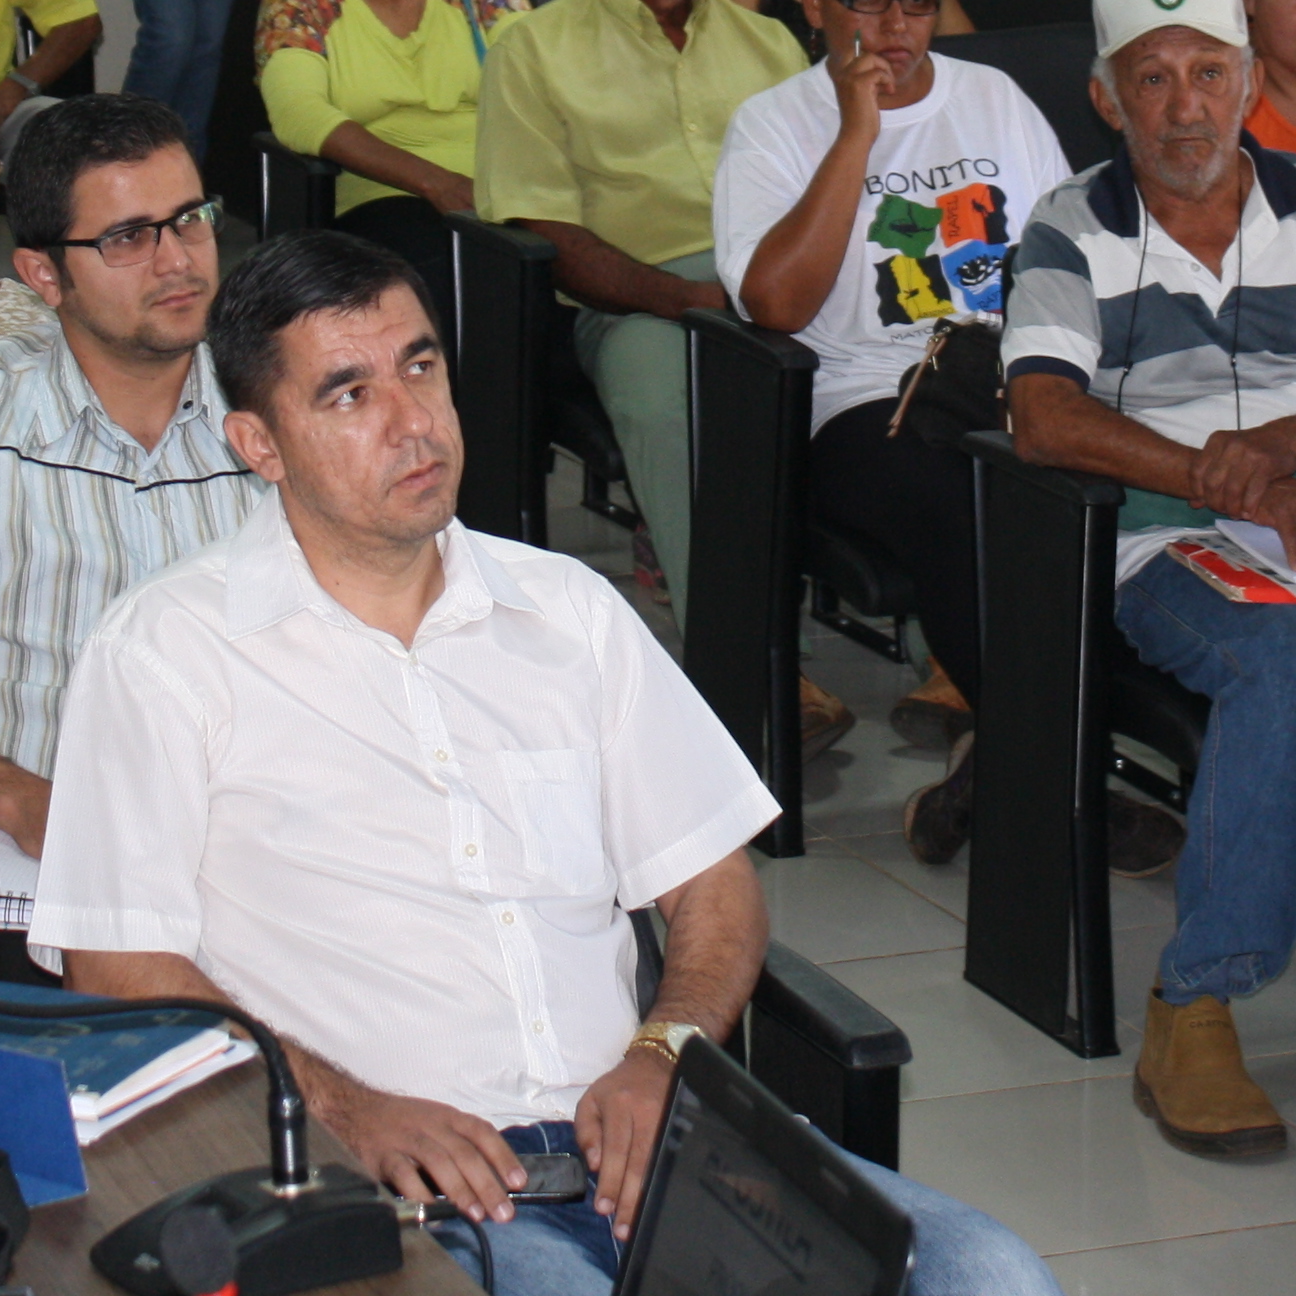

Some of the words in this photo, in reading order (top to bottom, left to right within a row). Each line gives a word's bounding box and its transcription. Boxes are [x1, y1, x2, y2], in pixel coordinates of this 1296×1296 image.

[864, 158, 999, 195] BONITO
[947, 195, 960, 239] RAPEL
[890, 325, 934, 344] MATO
